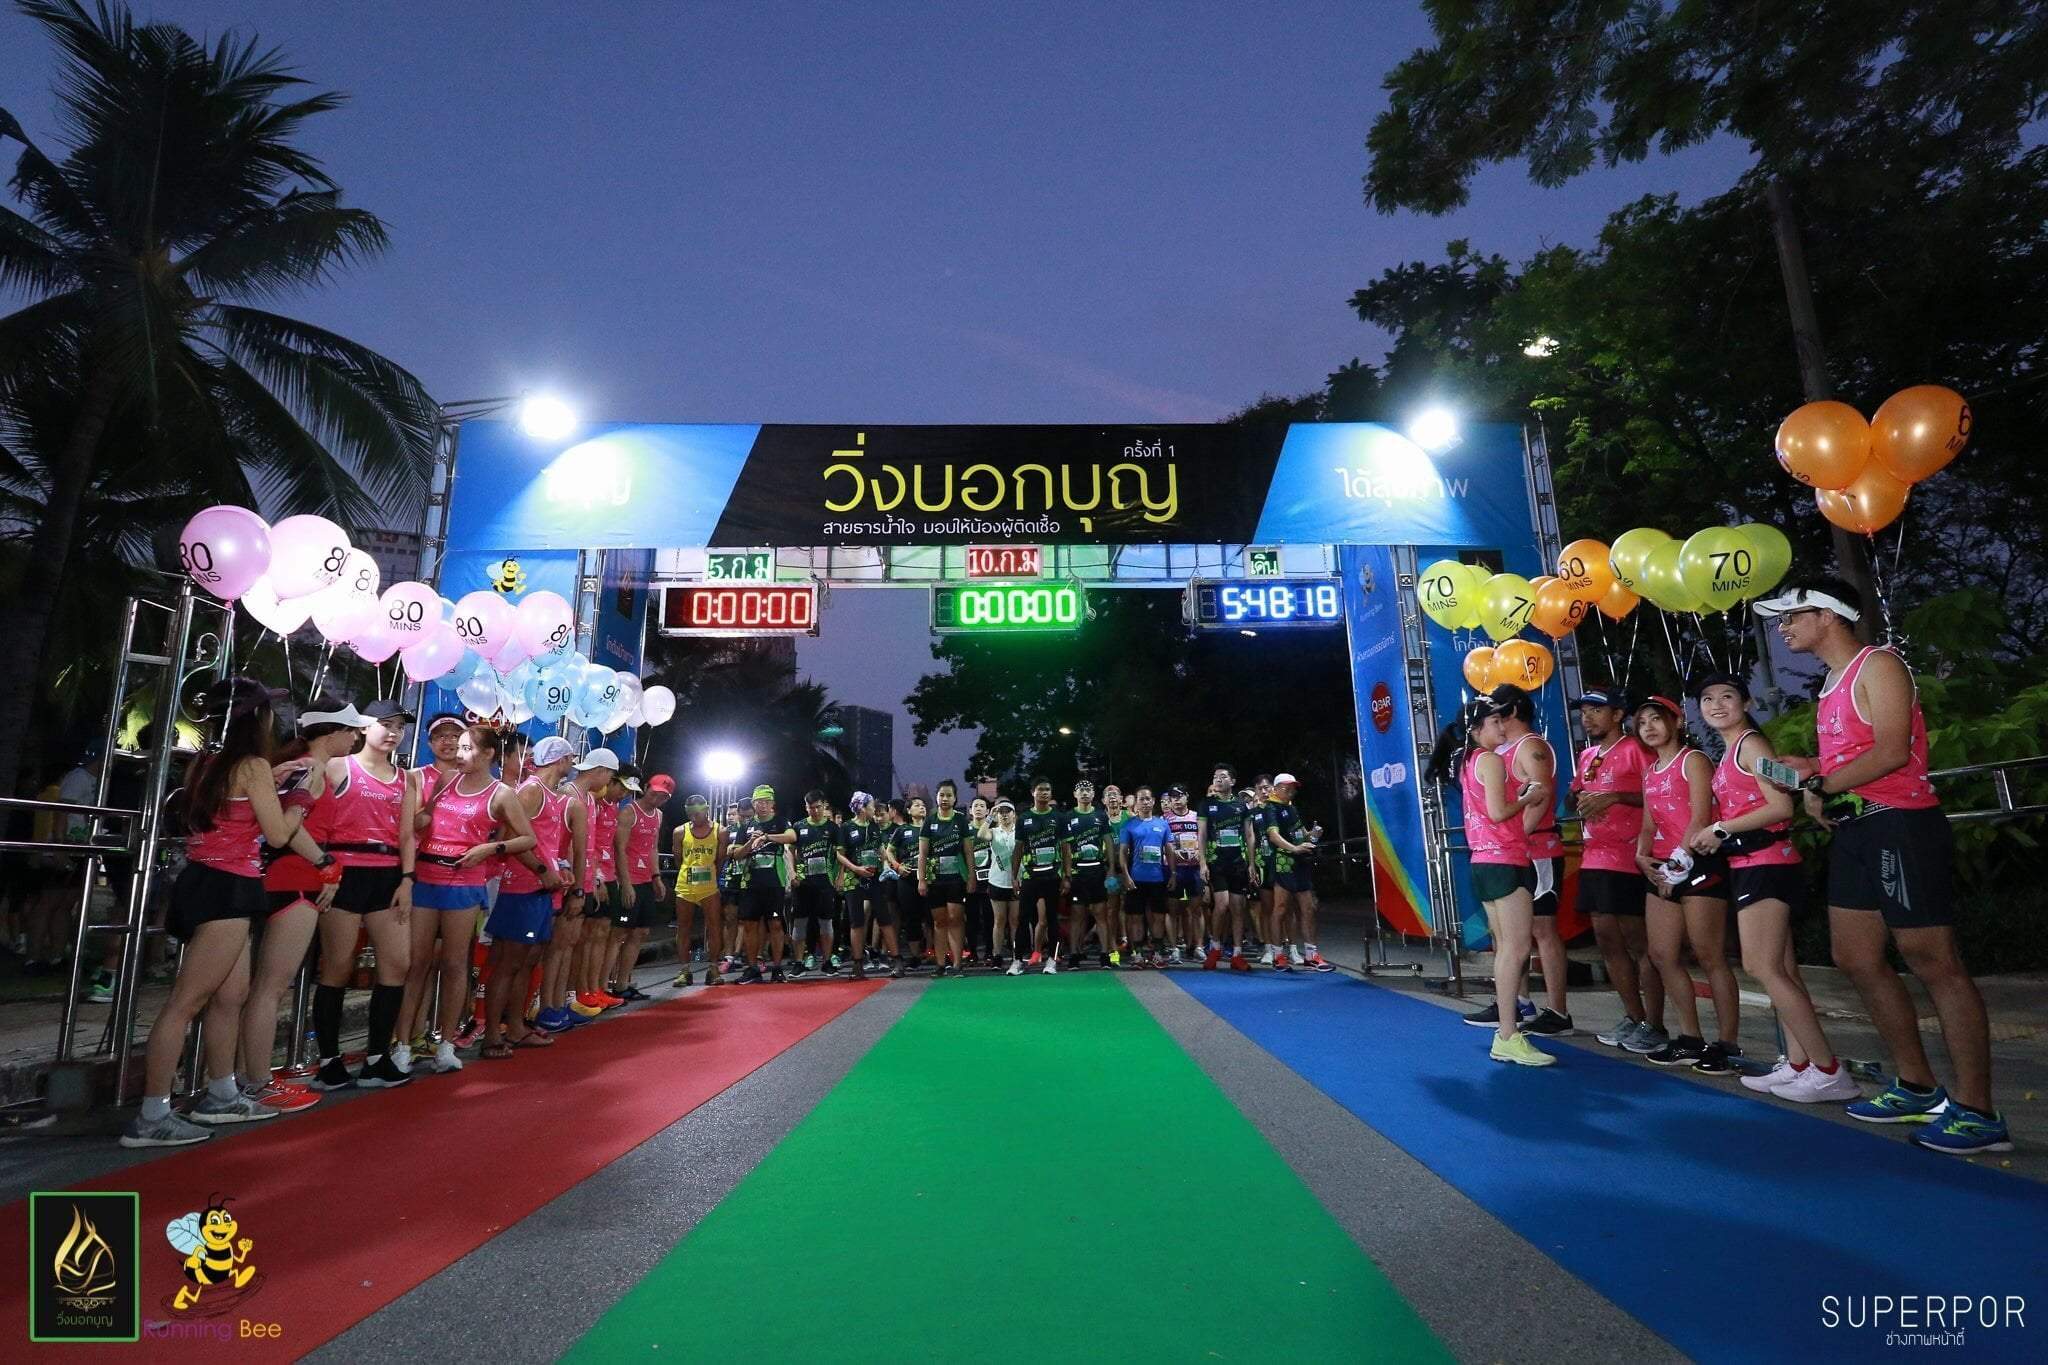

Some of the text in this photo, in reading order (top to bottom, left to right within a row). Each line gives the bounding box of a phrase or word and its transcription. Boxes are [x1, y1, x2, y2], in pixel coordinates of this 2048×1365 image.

[1124, 438, 1175, 458] ครั้งที่ 1
[823, 432, 1178, 533] วิ่งบอกบุญ
[823, 514, 1060, 538] สายธารน้ำใจ มอบให้น้องผู้ติดเชื้อ
[1560, 557, 1585, 581] 60
[1709, 550, 1751, 579] 70
[1423, 575, 1454, 601] 70
[1712, 576, 1750, 592] MINS
[389, 600, 423, 623] 80
[692, 592, 811, 625] 0:00:00
[959, 589, 1077, 625] 0:00:00
[1222, 585, 1338, 620] 5:48:18
[1427, 597, 1458, 612] MINS
[389, 620, 422, 632] MINS
[456, 616, 483, 637] 80
[547, 686, 571, 705] 90
